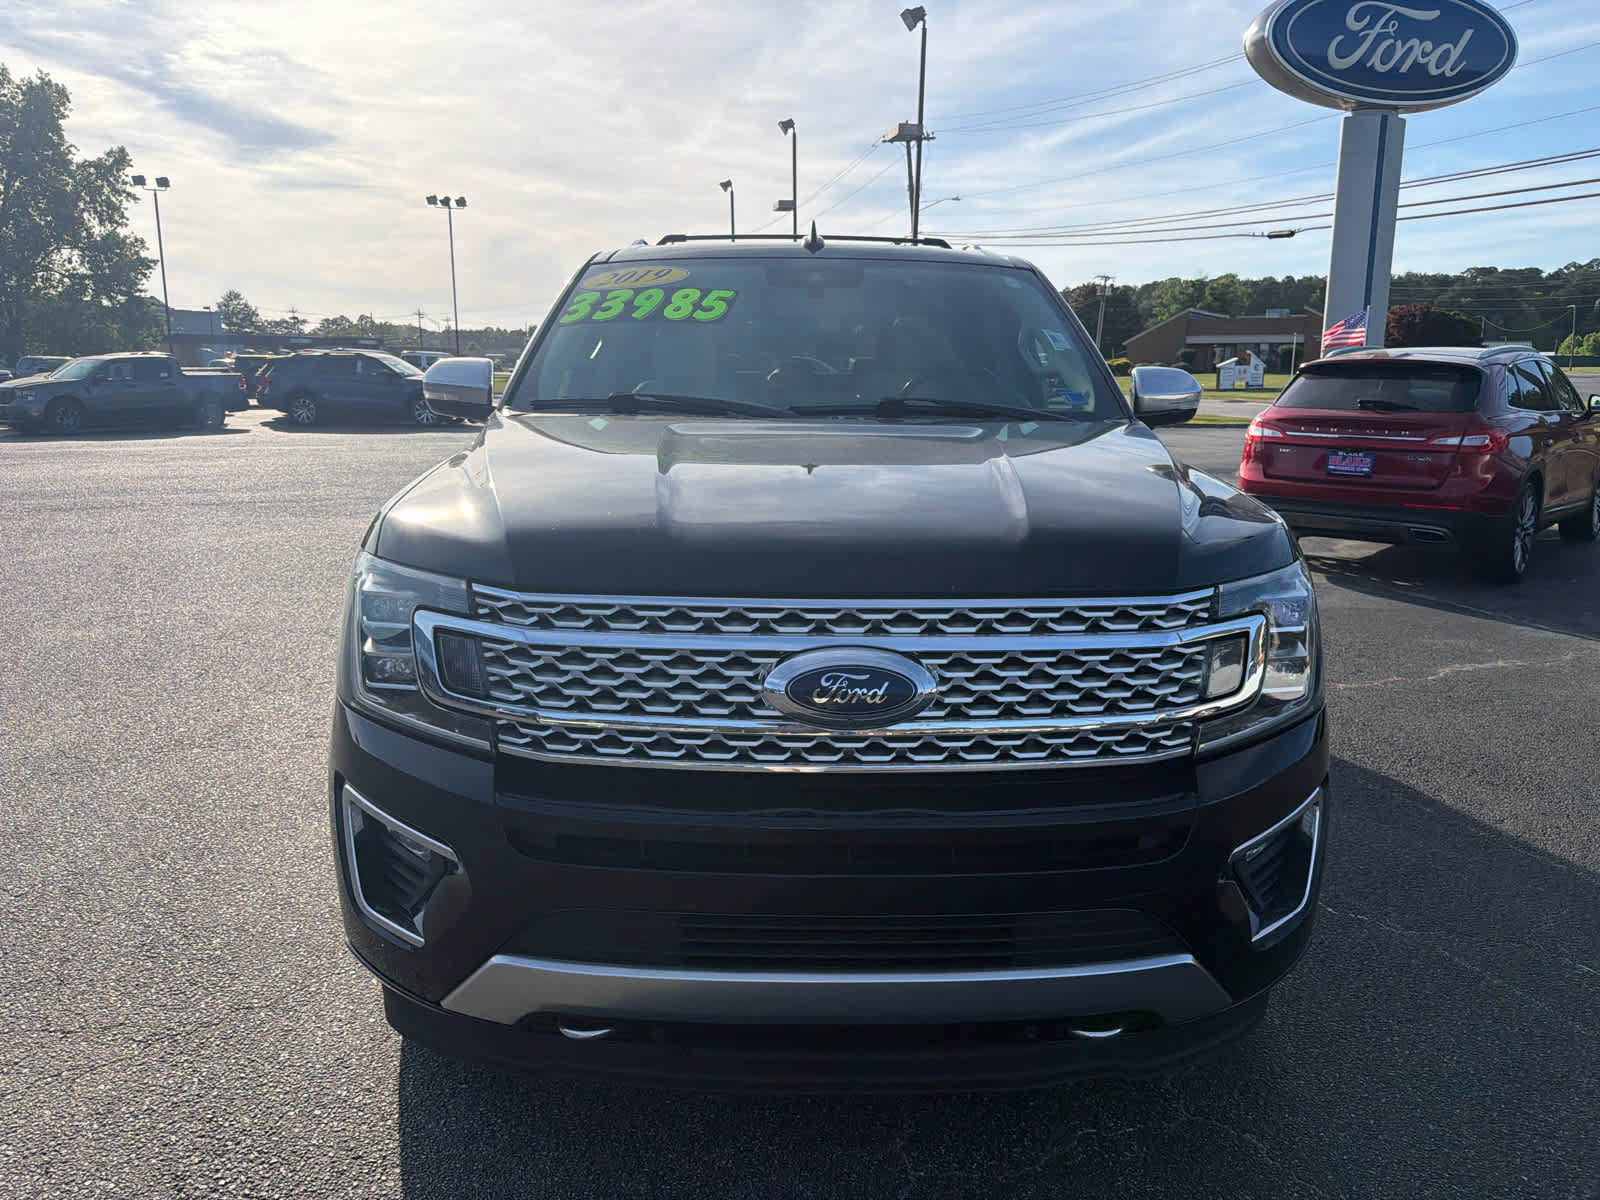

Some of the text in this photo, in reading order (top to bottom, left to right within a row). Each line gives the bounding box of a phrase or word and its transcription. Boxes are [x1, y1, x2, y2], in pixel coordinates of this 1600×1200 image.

[1327, 1, 1474, 77] Ford
[597, 268, 673, 287] 2019
[560, 288, 736, 323] 33985
[812, 672, 889, 704] Ford
